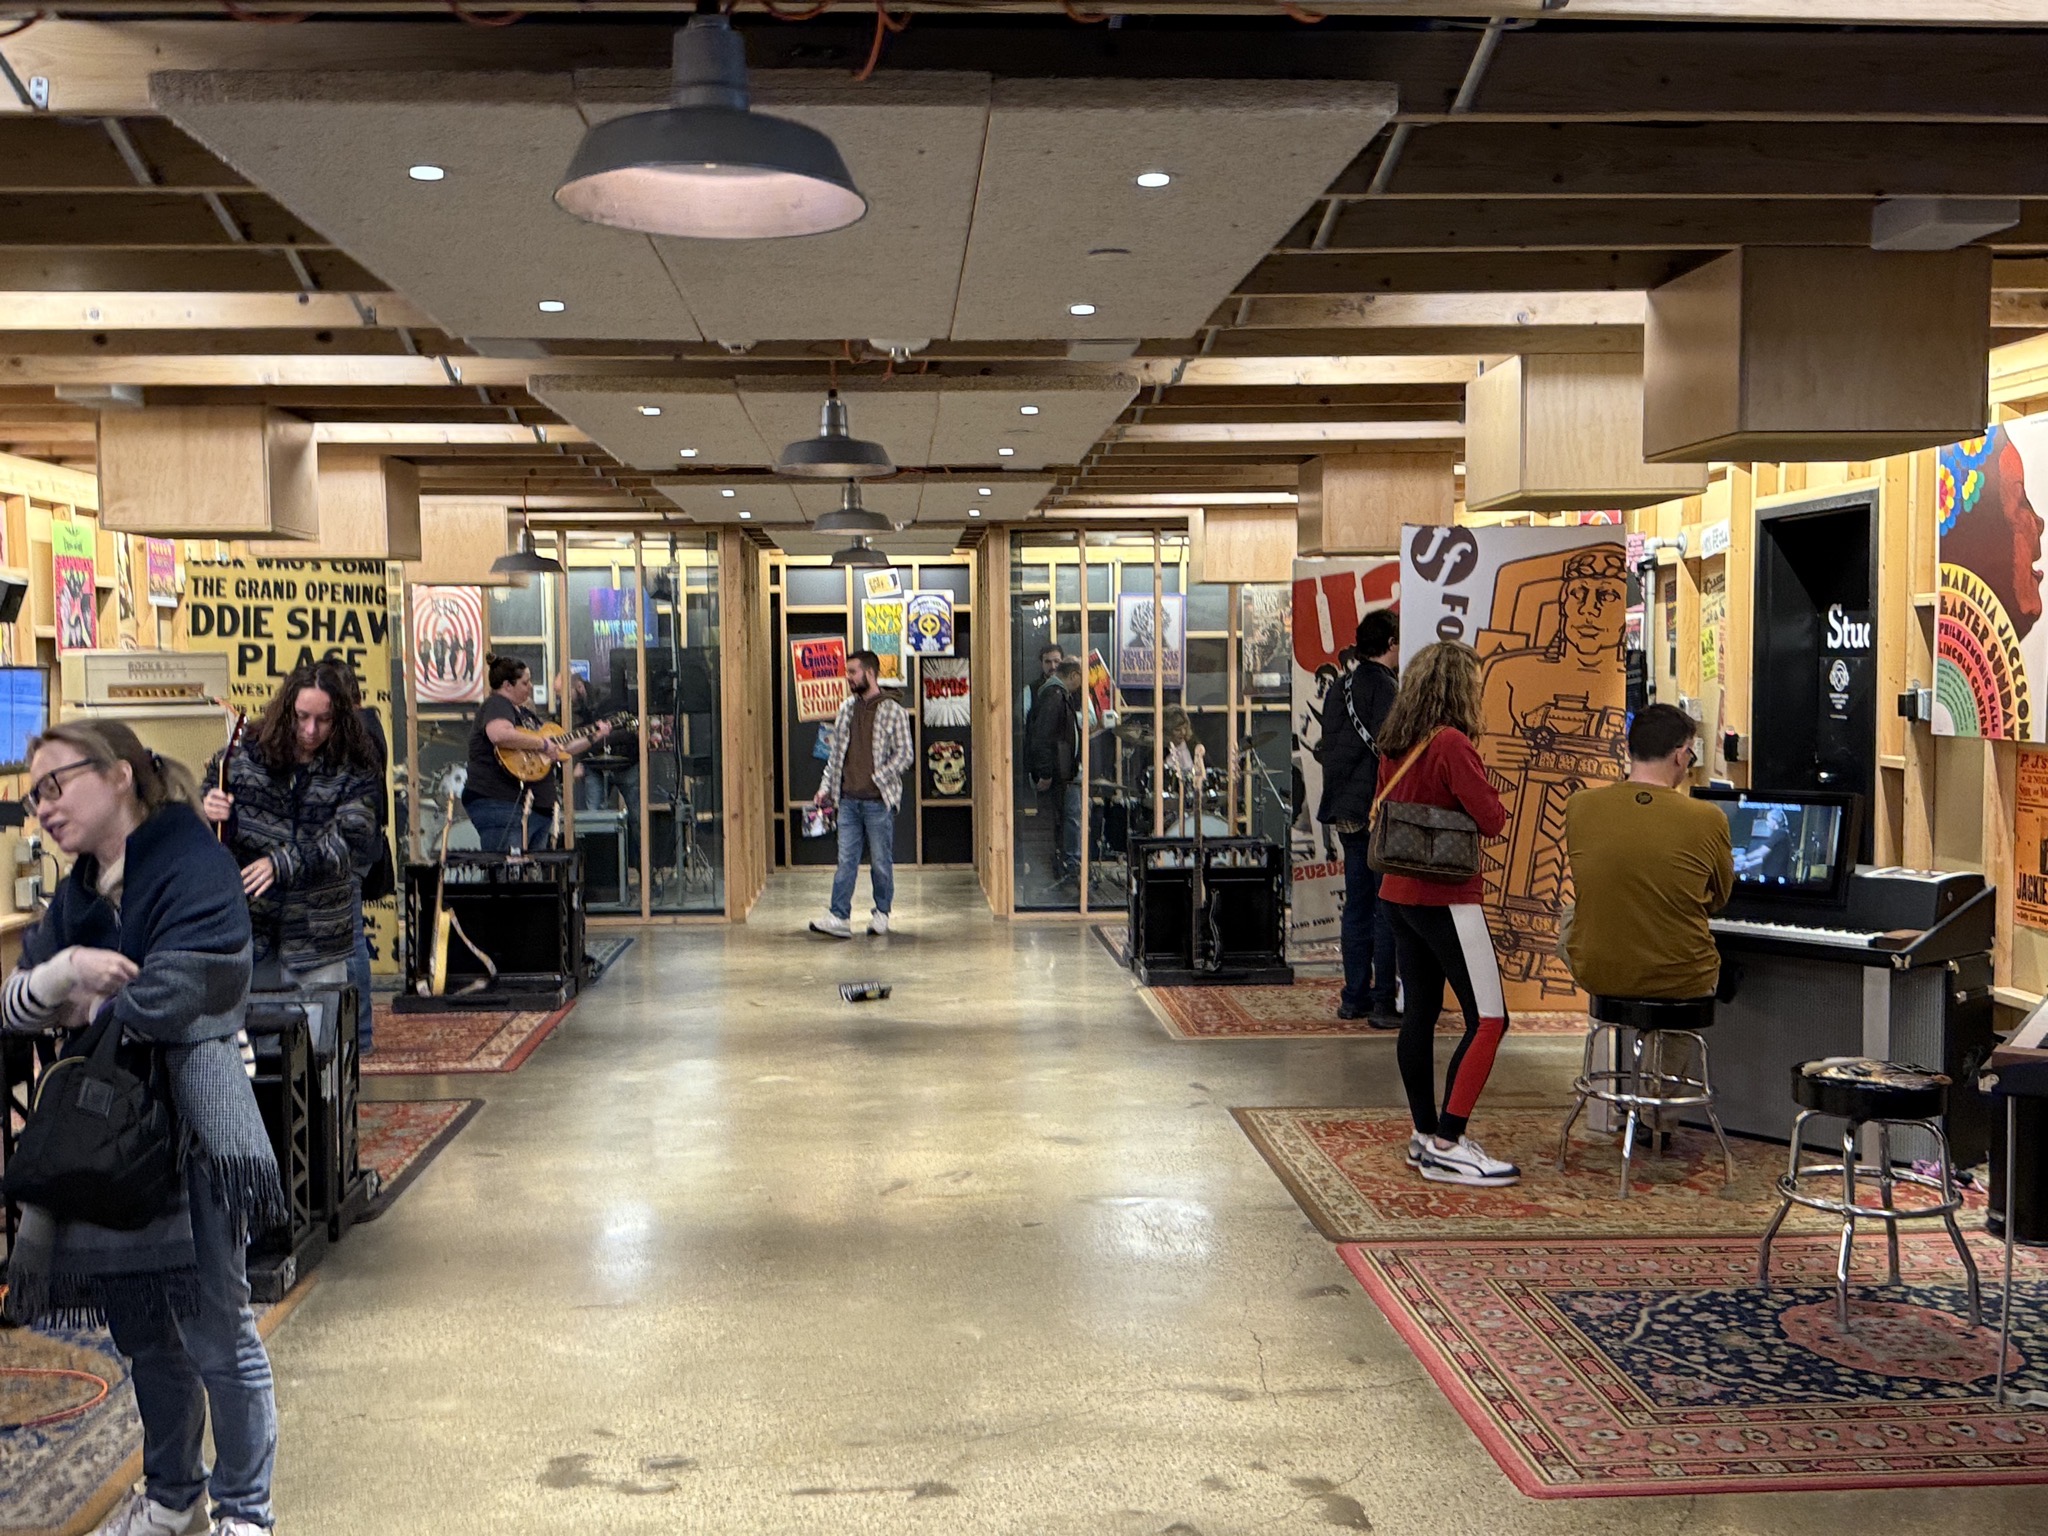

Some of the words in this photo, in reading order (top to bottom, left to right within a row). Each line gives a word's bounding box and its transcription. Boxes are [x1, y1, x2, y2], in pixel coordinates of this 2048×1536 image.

[191, 576, 227, 598] THE
[235, 577, 298, 600] GRAND
[305, 580, 387, 605] OPENING
[186, 602, 274, 639] DDIE
[1940, 595, 1990, 647] EASTER
[1987, 642, 2015, 741] SUNDAY
[1941, 567, 1997, 627] MAHALIA
[1997, 622, 2031, 740] JACKSON
[231, 683, 274, 698] WEST
[801, 683, 844, 702] DRUM
[1938, 641, 1972, 677] LINCOLN
[1971, 675, 1989, 737] CENTER
[1939, 622, 1992, 690] PHILHARMONIC
[1988, 692, 1999, 733] HALL
[2016, 871, 2048, 907] JACKIE
